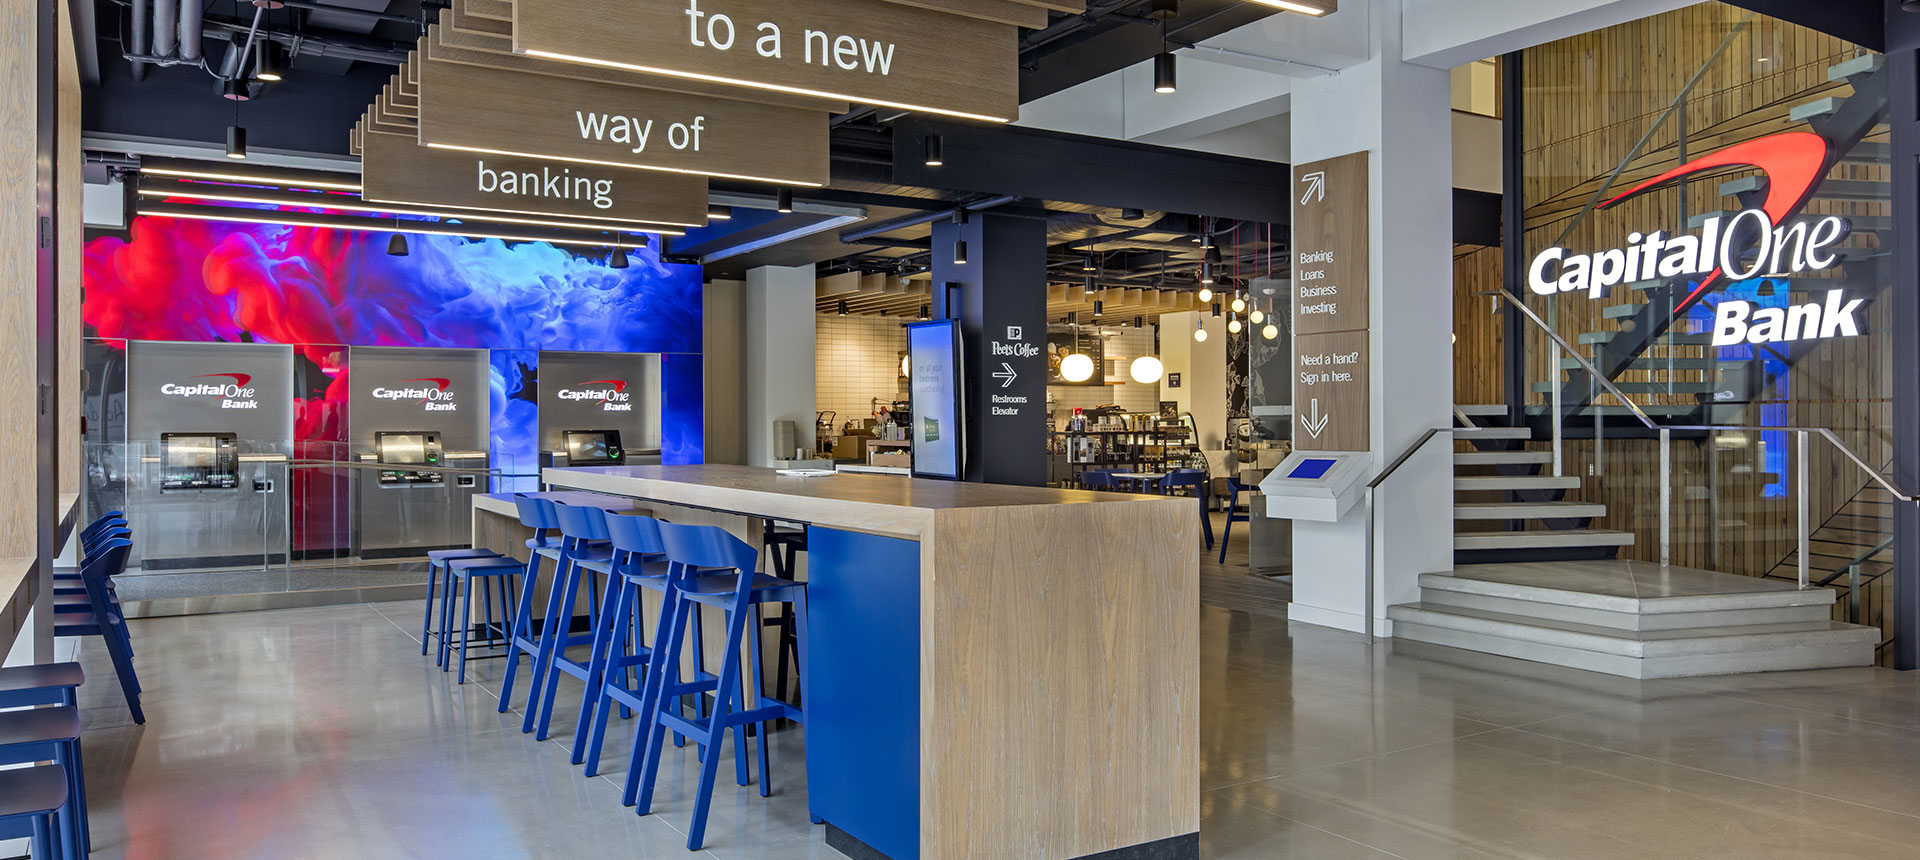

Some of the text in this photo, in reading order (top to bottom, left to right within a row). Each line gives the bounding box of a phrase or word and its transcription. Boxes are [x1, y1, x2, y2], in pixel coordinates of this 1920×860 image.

[685, 0, 895, 75] to a new
[576, 111, 705, 154] way of
[478, 160, 613, 209] banking
[1300, 250, 1334, 264] Banking
[1300, 270, 1325, 281] Loans
[1300, 285, 1337, 298] Business
[1300, 301, 1337, 315] Investing
[1711, 288, 1865, 347] Bank
[1013, 343, 1040, 358] Coffee
[1301, 351, 1359, 366] Need a hand?
[1300, 370, 1353, 386] Sign in here.
[221, 399, 258, 409] Bank
[992, 394, 1028, 404] Restrooms
[424, 402, 457, 411] Bank
[603, 402, 632, 411] Bank
[992, 406, 1019, 416] Elevator
